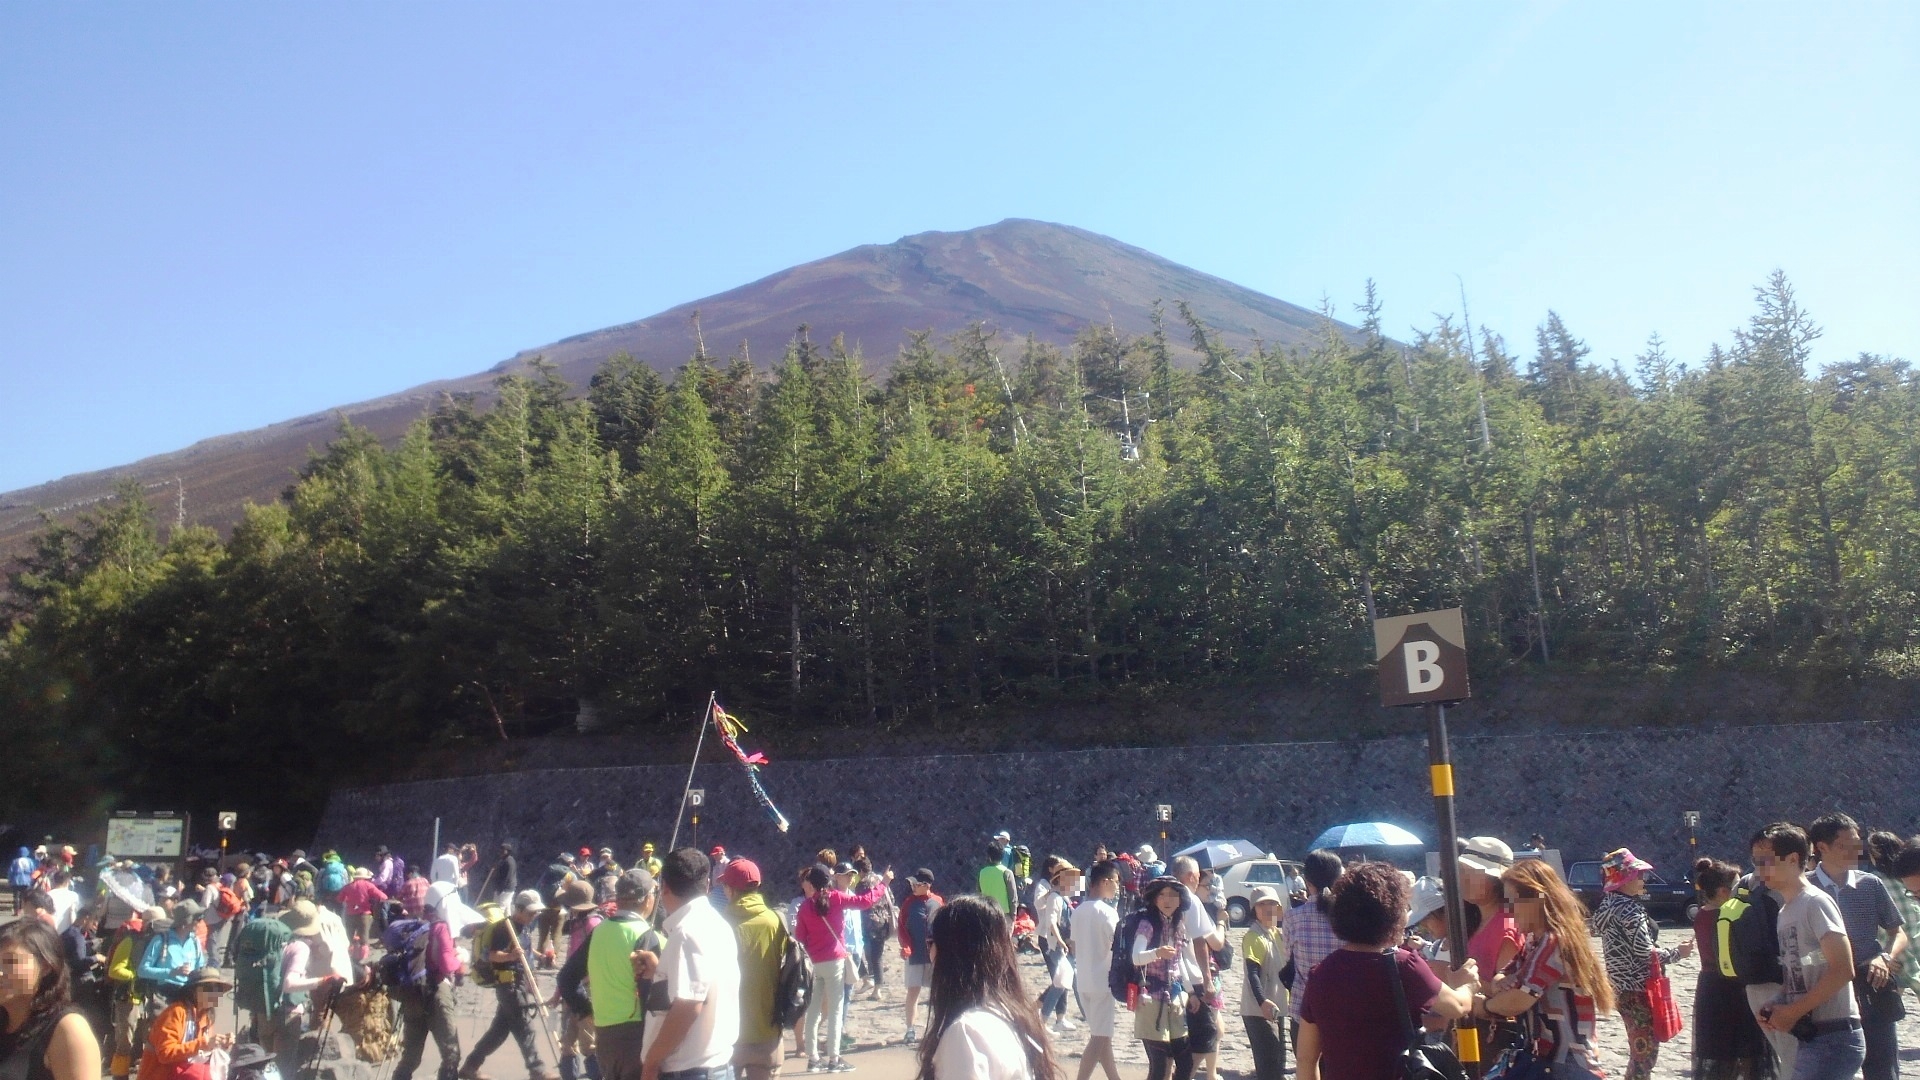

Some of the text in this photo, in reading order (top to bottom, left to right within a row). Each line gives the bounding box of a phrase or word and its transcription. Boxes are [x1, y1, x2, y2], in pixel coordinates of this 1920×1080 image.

[1404, 640, 1445, 694] B
[692, 794, 701, 805] D
[1162, 809, 1169, 821] E
[1690, 815, 1697, 827] F
[223, 816, 231, 829] C
